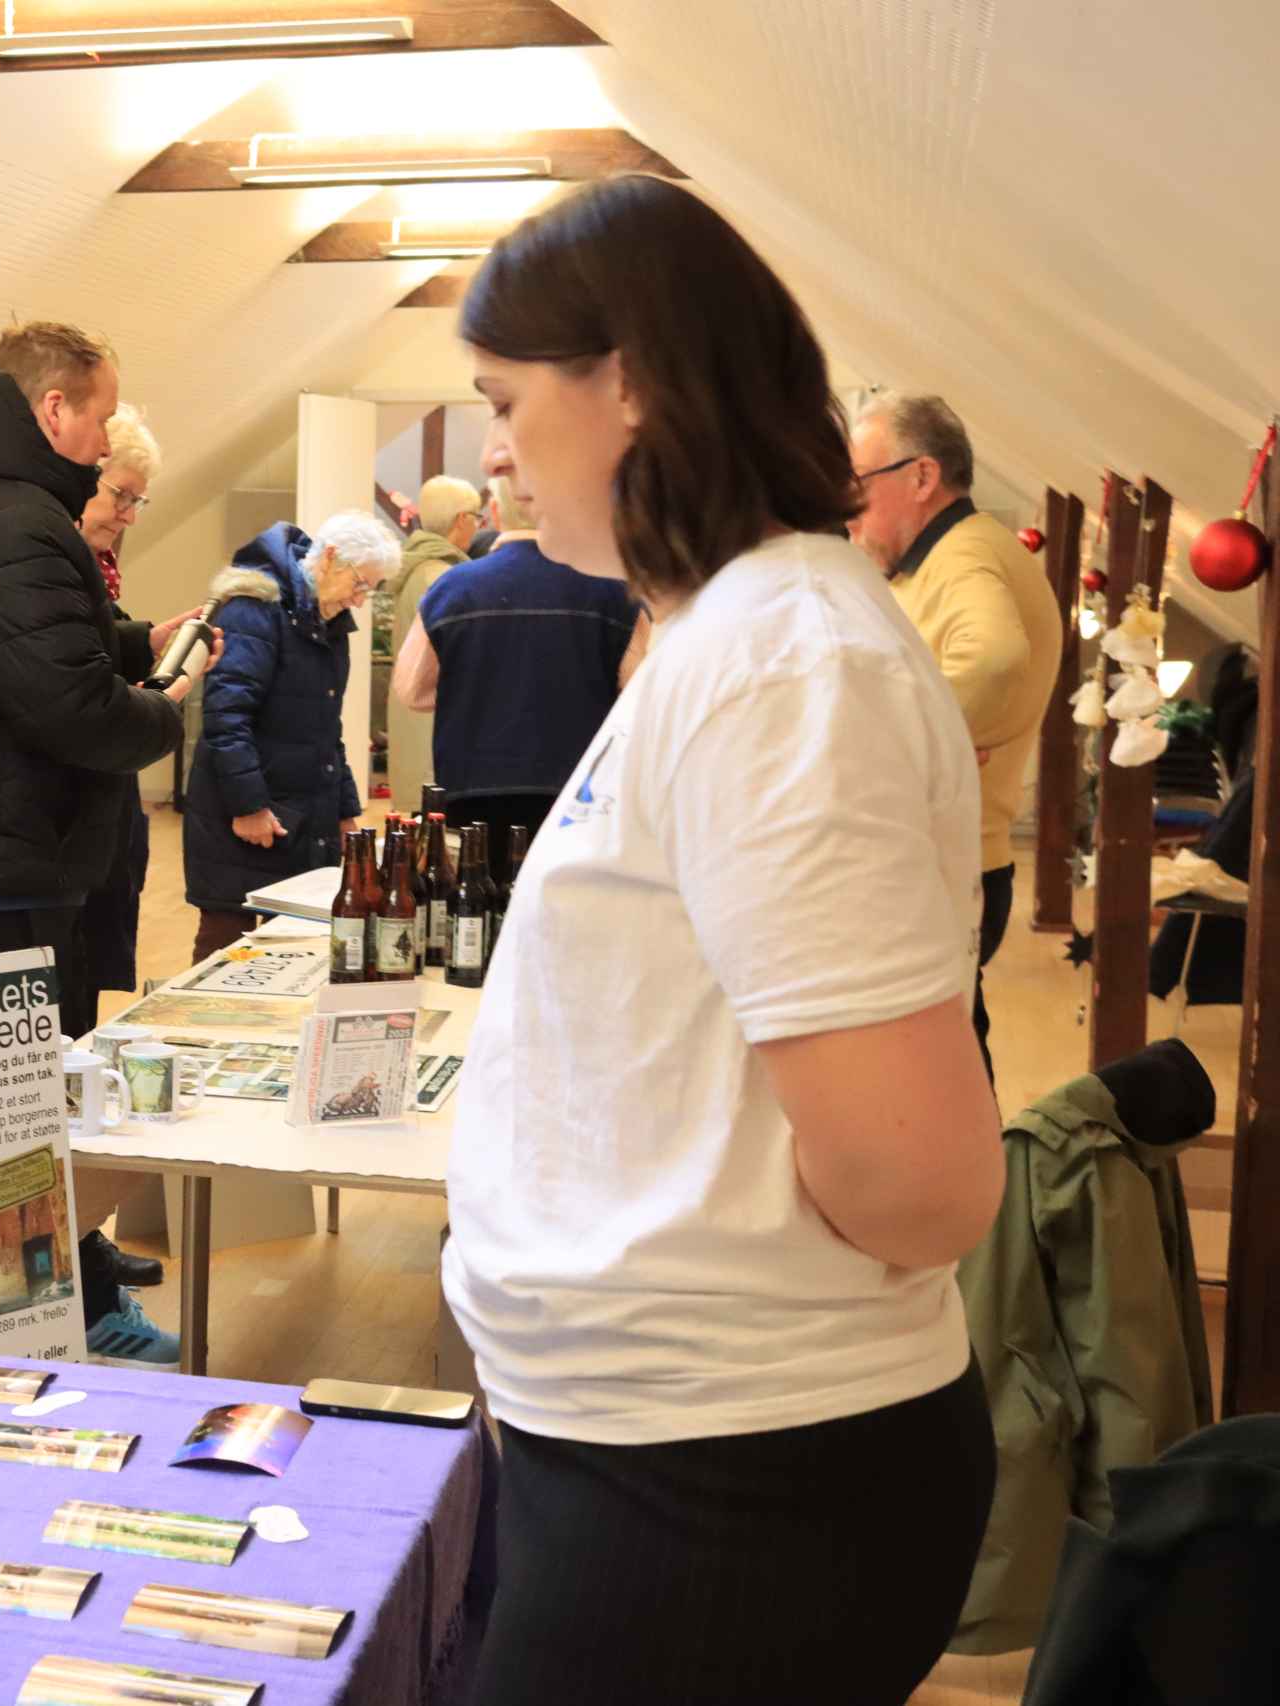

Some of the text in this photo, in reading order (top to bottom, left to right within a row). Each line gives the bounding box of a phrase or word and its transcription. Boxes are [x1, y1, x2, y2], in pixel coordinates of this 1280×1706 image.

[11, 1055, 25, 1066] du
[27, 1051, 41, 1064] får
[44, 1050, 57, 1061] en
[12, 1071, 35, 1084] som
[37, 1067, 56, 1080] tak.
[6, 1096, 17, 1108] et
[18, 1092, 41, 1106] stort
[8, 1106, 59, 1125] borgernes
[4, 1129, 18, 1143] for
[20, 1127, 31, 1141] at
[32, 1123, 61, 1138] støtte
[43, 1344, 68, 1360] eller
